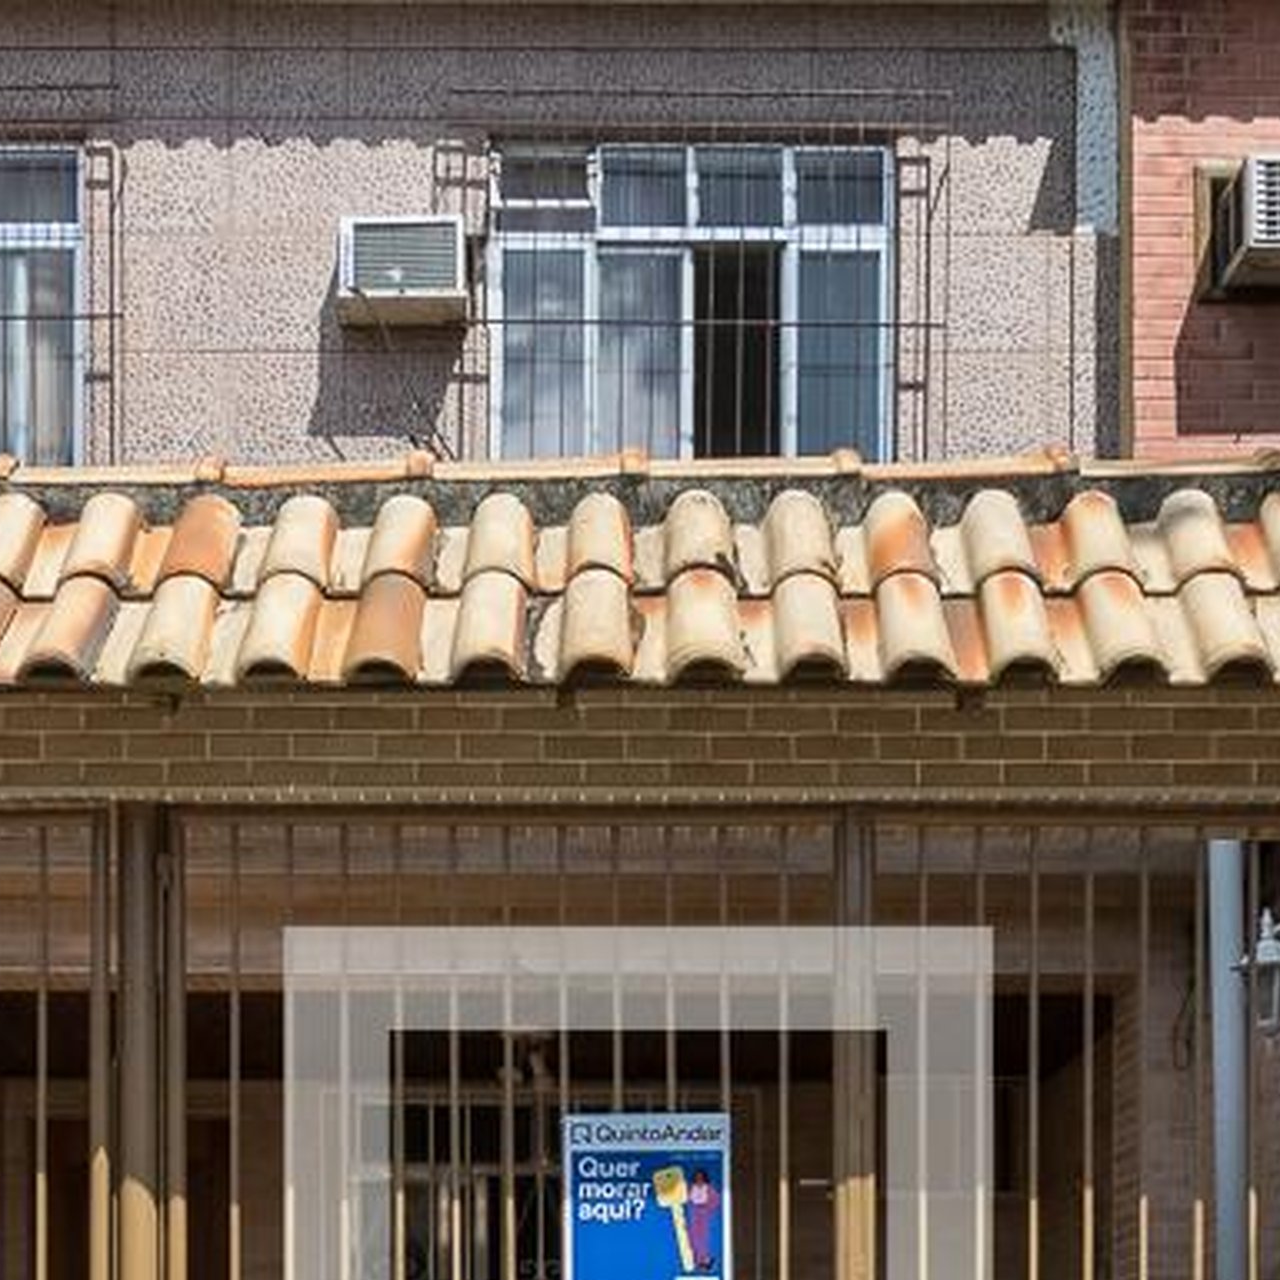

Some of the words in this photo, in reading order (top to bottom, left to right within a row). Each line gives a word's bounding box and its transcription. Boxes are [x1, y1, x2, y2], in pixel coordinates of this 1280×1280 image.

[596, 1125, 721, 1144] QuintoAndar
[578, 1157, 640, 1178] Quer
[578, 1182, 650, 1198] morar
[578, 1199, 645, 1223] aqui?
